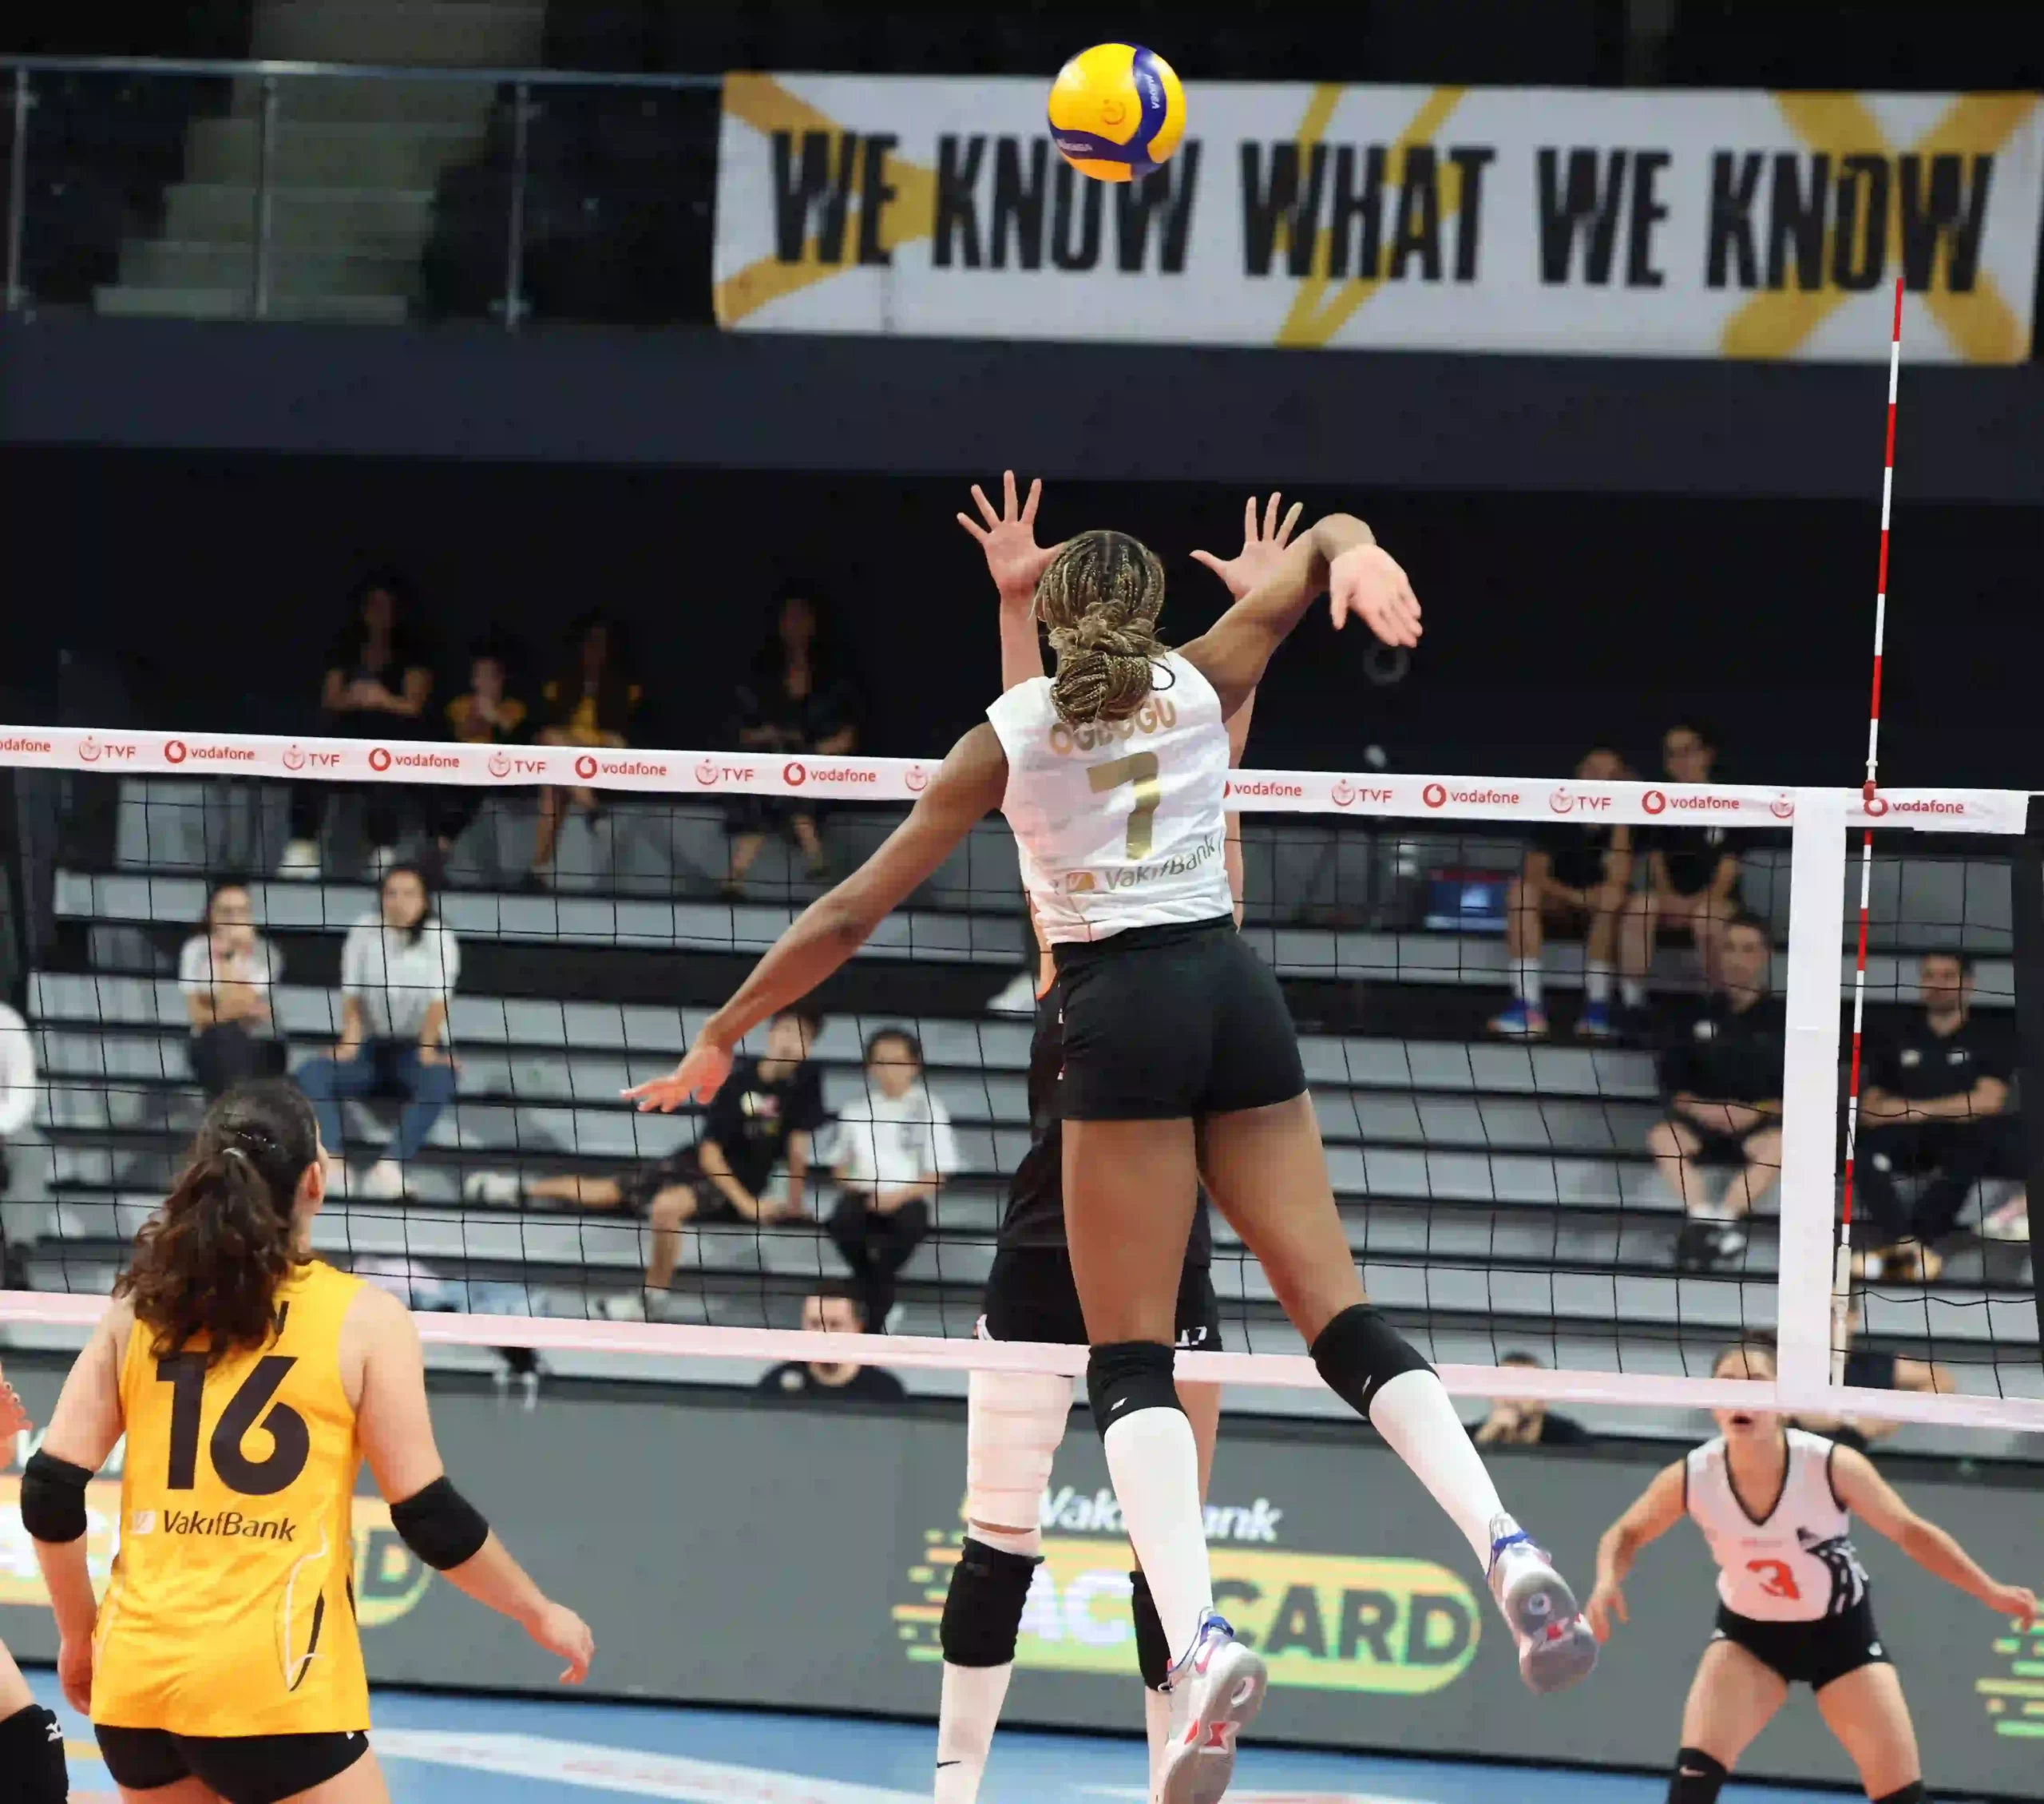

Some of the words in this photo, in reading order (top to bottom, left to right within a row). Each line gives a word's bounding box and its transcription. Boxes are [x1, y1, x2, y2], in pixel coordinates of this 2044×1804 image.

[771, 130, 900, 265] WE
[932, 133, 1199, 274] KNOW
[1238, 140, 1496, 281] WHAT
[1535, 146, 1672, 288] WE
[1704, 149, 1996, 293] KNOW
[105, 745, 136, 759] TVF
[191, 747, 256, 761] vodafone
[309, 753, 341, 767] TVF
[394, 755, 461, 768] vodafone
[514, 759, 546, 773] TVF
[600, 763, 667, 777] vodafone
[722, 768, 755, 782] TVF
[810, 769, 877, 783] vodafone
[1234, 783, 1303, 797] vodafone
[1360, 789, 1393, 803] TVF
[1450, 791, 1519, 805] vodafone
[1577, 796, 1612, 811] TVF
[1670, 796, 1741, 811] vodafone
[1087, 751, 1160, 861] 7
[1891, 800, 1965, 815] vodafone
[156, 1350, 311, 1496] 16
